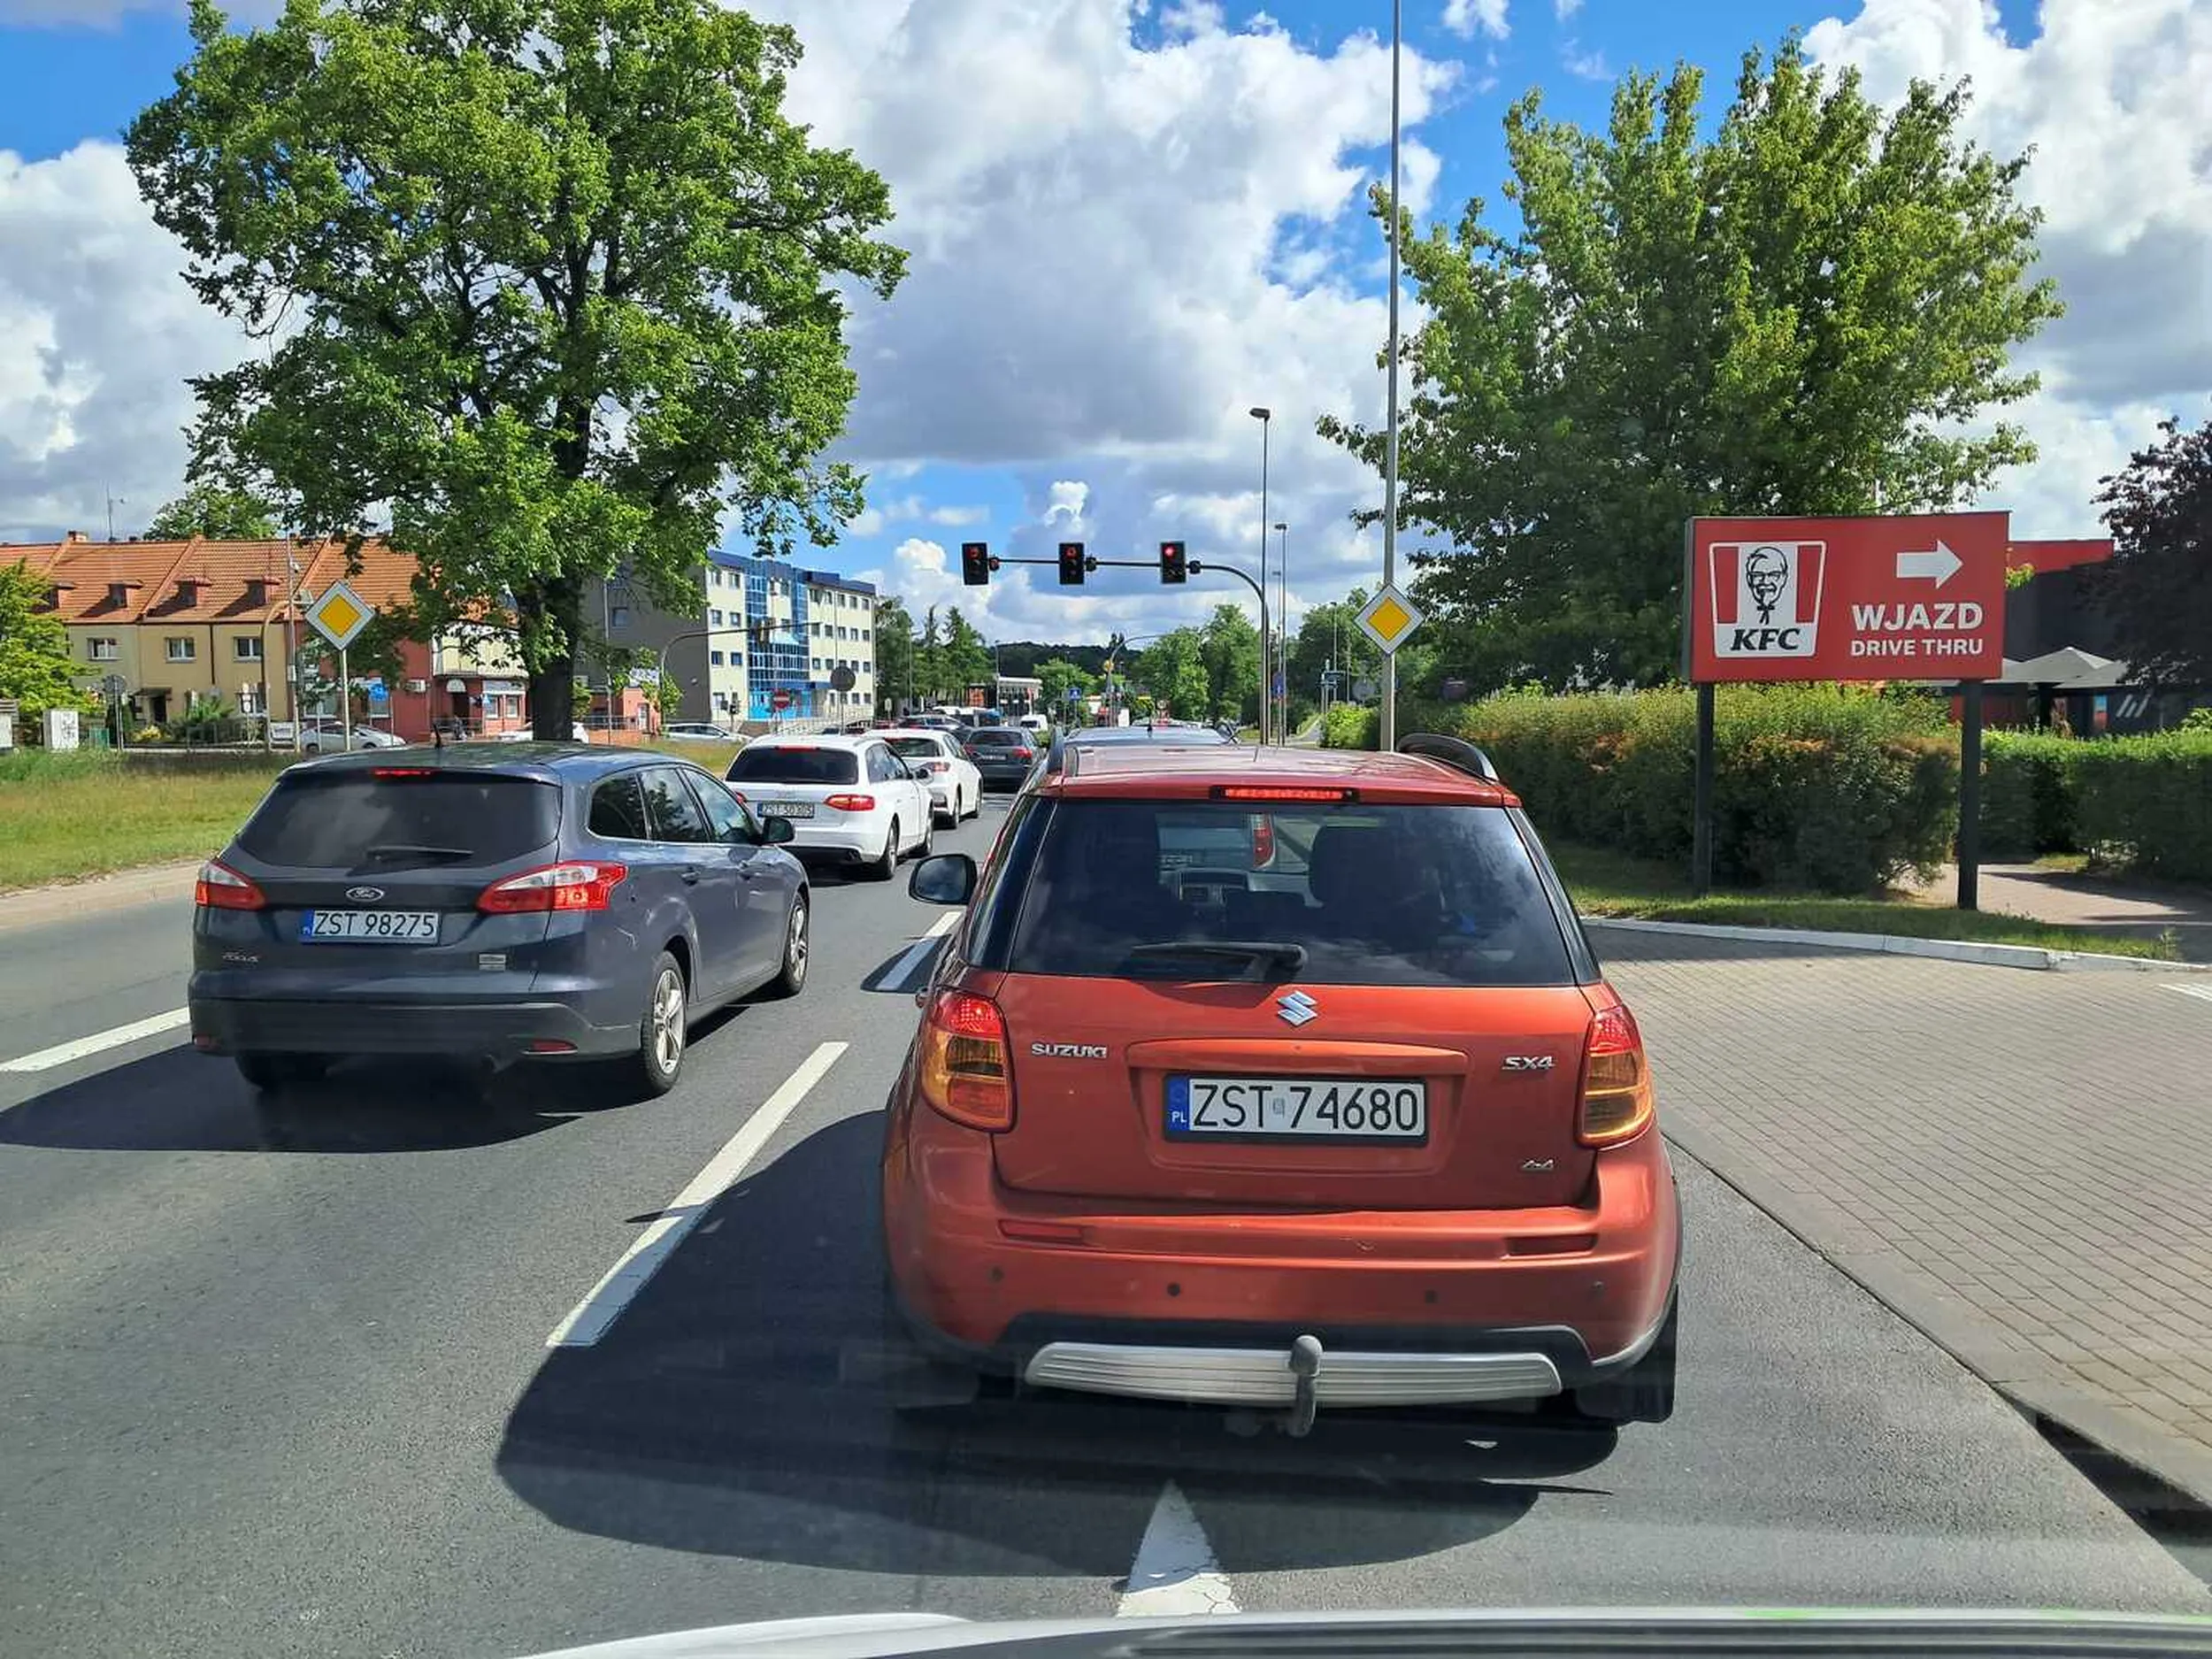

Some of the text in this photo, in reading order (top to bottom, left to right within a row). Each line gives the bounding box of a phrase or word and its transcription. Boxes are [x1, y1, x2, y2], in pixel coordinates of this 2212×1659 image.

[1851, 602, 1984, 631] WJAZD
[1730, 627, 1801, 651] KFC
[1850, 638, 1984, 657] DRIVE THRU
[314, 912, 434, 936] ZST 98275
[1502, 1056, 1555, 1071] SX4
[1171, 1111, 1187, 1123] PL
[1194, 1084, 1418, 1132] ZST 74680
